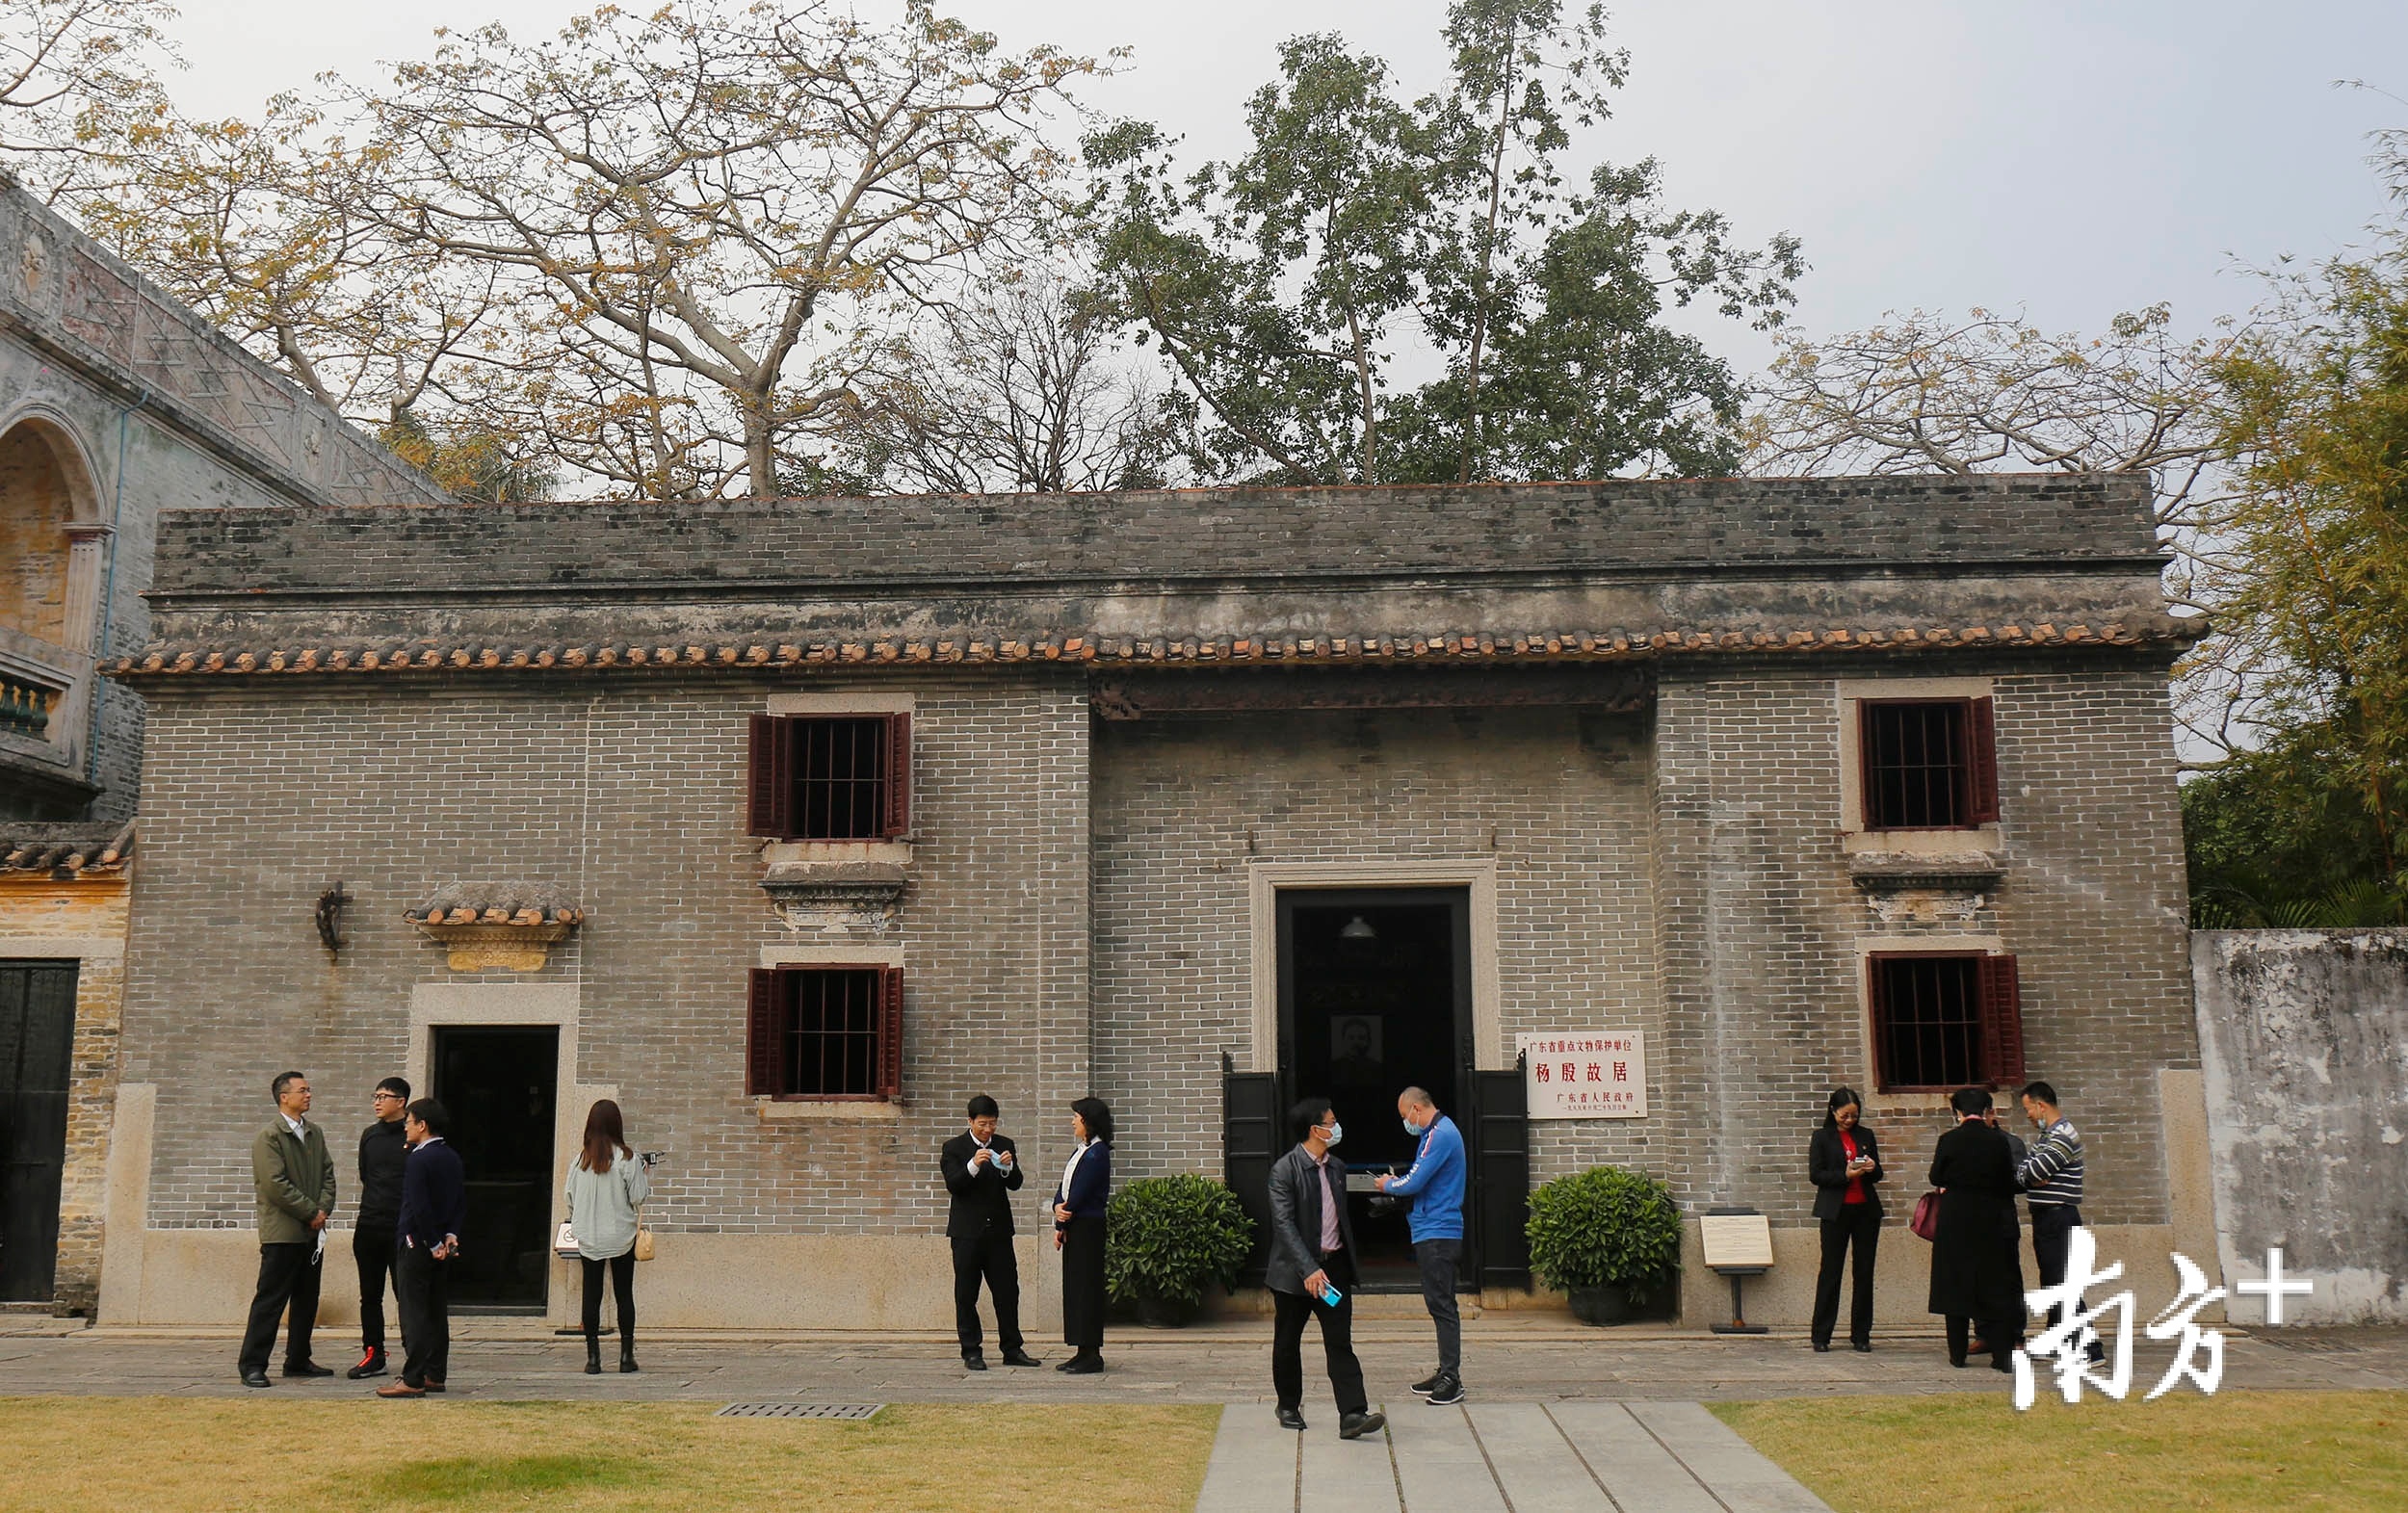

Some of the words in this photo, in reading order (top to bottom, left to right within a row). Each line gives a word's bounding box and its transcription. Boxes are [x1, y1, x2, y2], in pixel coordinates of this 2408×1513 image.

[1530, 1039, 1632, 1054] 广东省重点文物保护单位
[1535, 1061, 1627, 1083] 杨殷故居
[1557, 1091, 1634, 1104] 广东省人民政府
